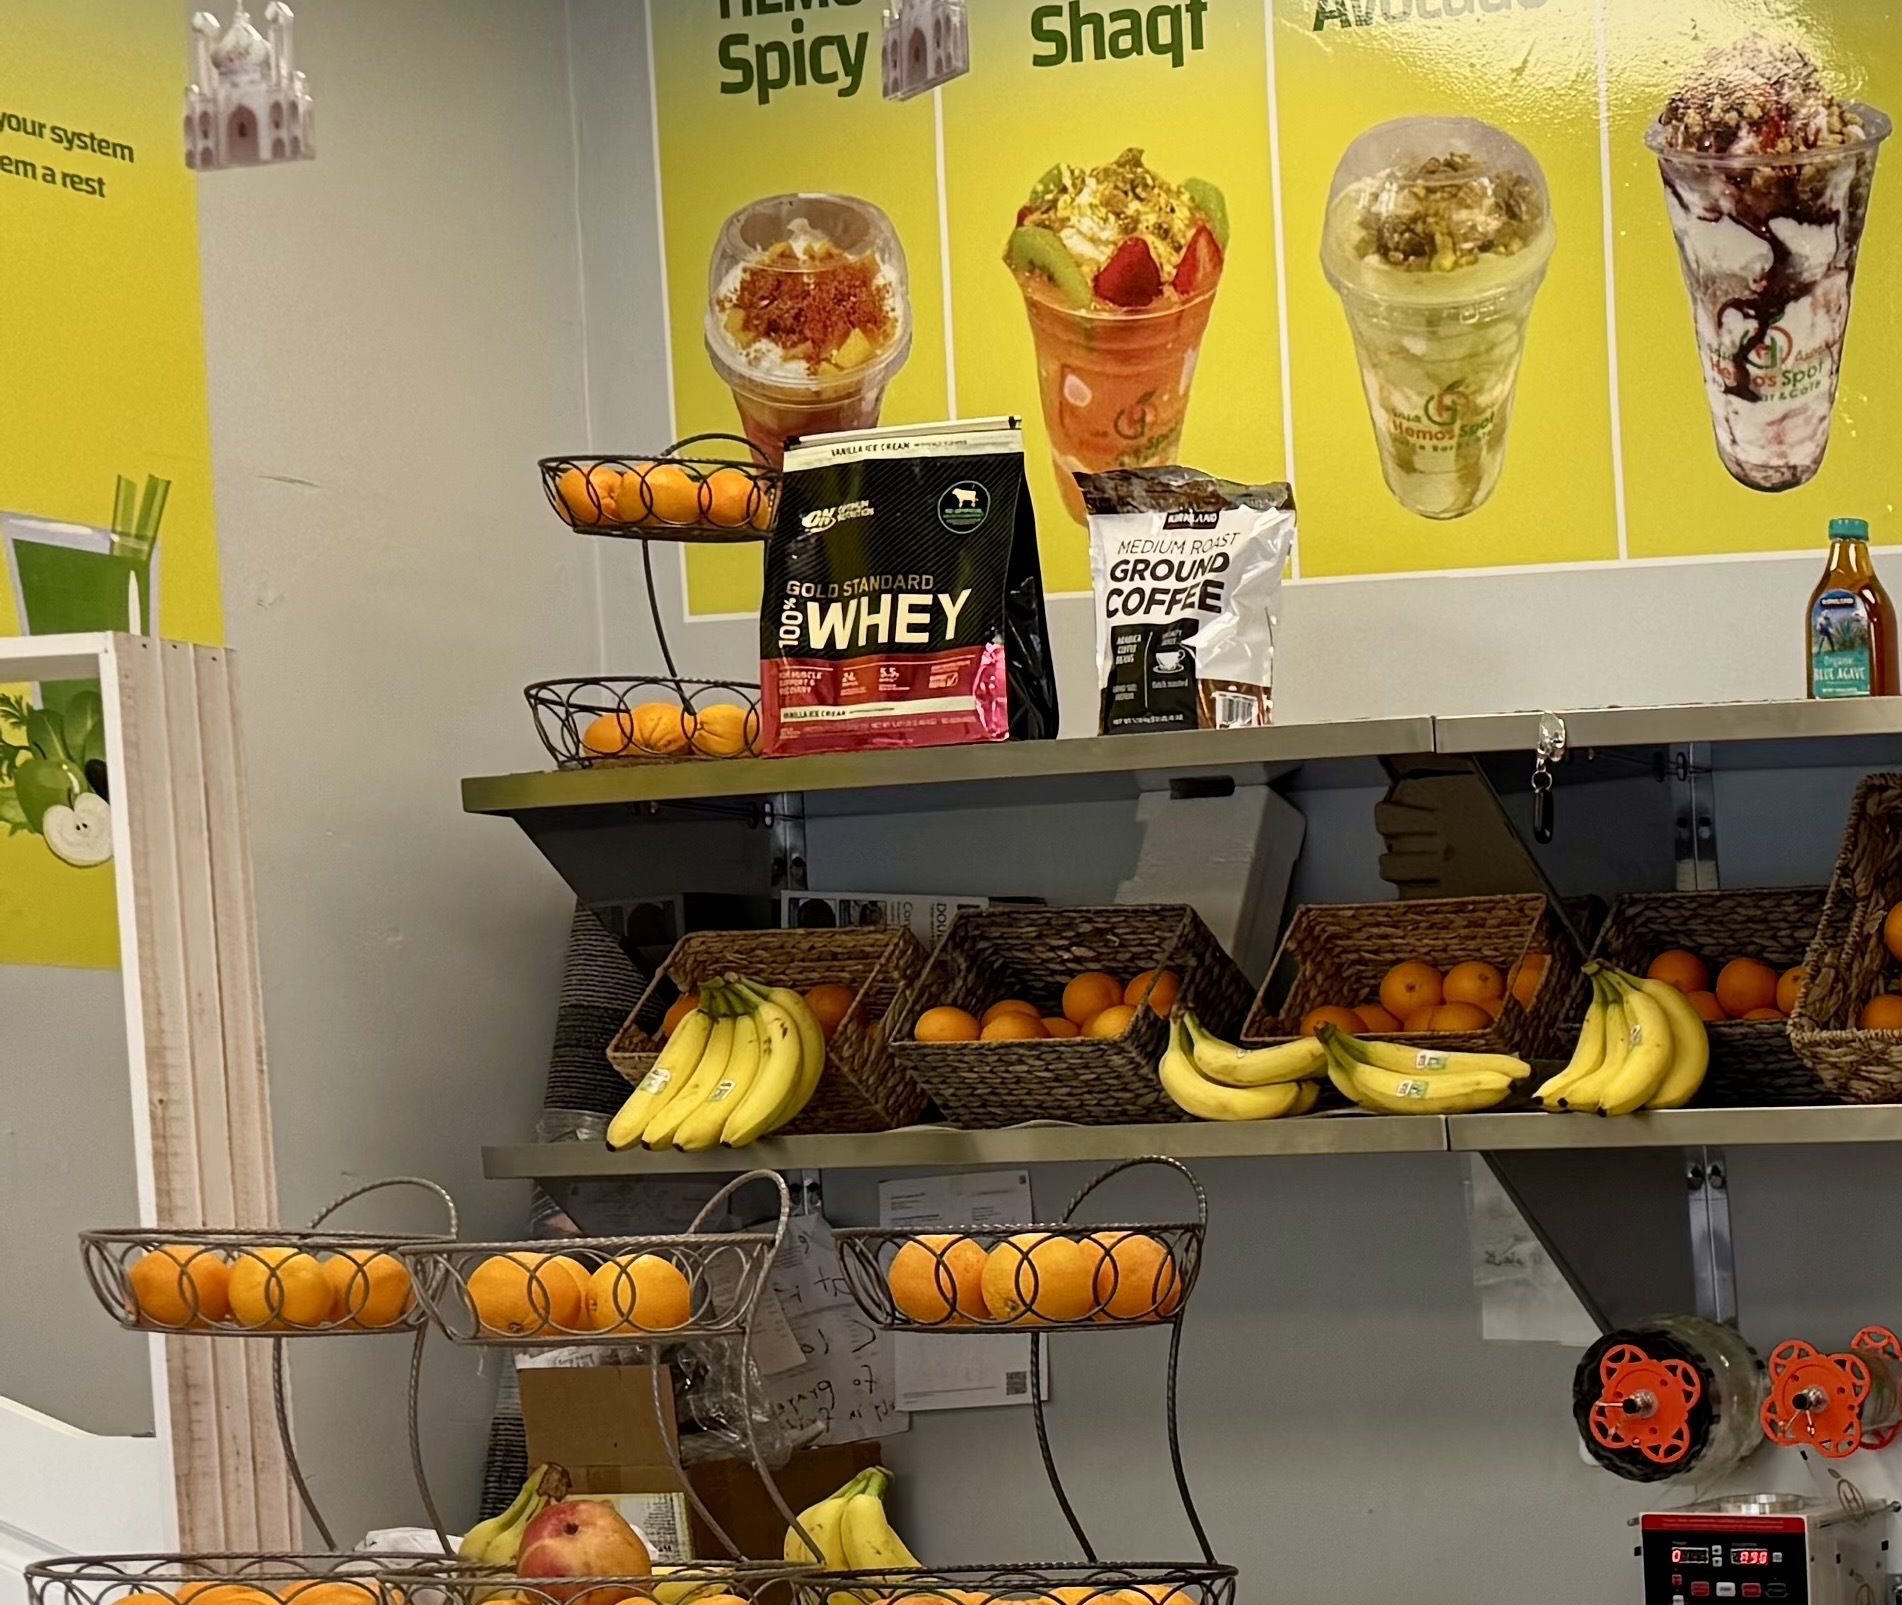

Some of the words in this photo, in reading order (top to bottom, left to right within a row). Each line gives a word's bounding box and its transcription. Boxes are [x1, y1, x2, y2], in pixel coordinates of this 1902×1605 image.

[718, 20, 869, 105] Spicy
[50, 125, 134, 163] system
[41, 166, 56, 184] a
[61, 171, 106, 198] rest
[1118, 539, 1185, 555] MEDIUM
[1110, 552, 1230, 583] GROUND
[786, 580, 839, 598] GOLD
[843, 575, 934, 596] STANDARD
[1106, 579, 1225, 619] COFFEE
[806, 589, 972, 650] WHEY
